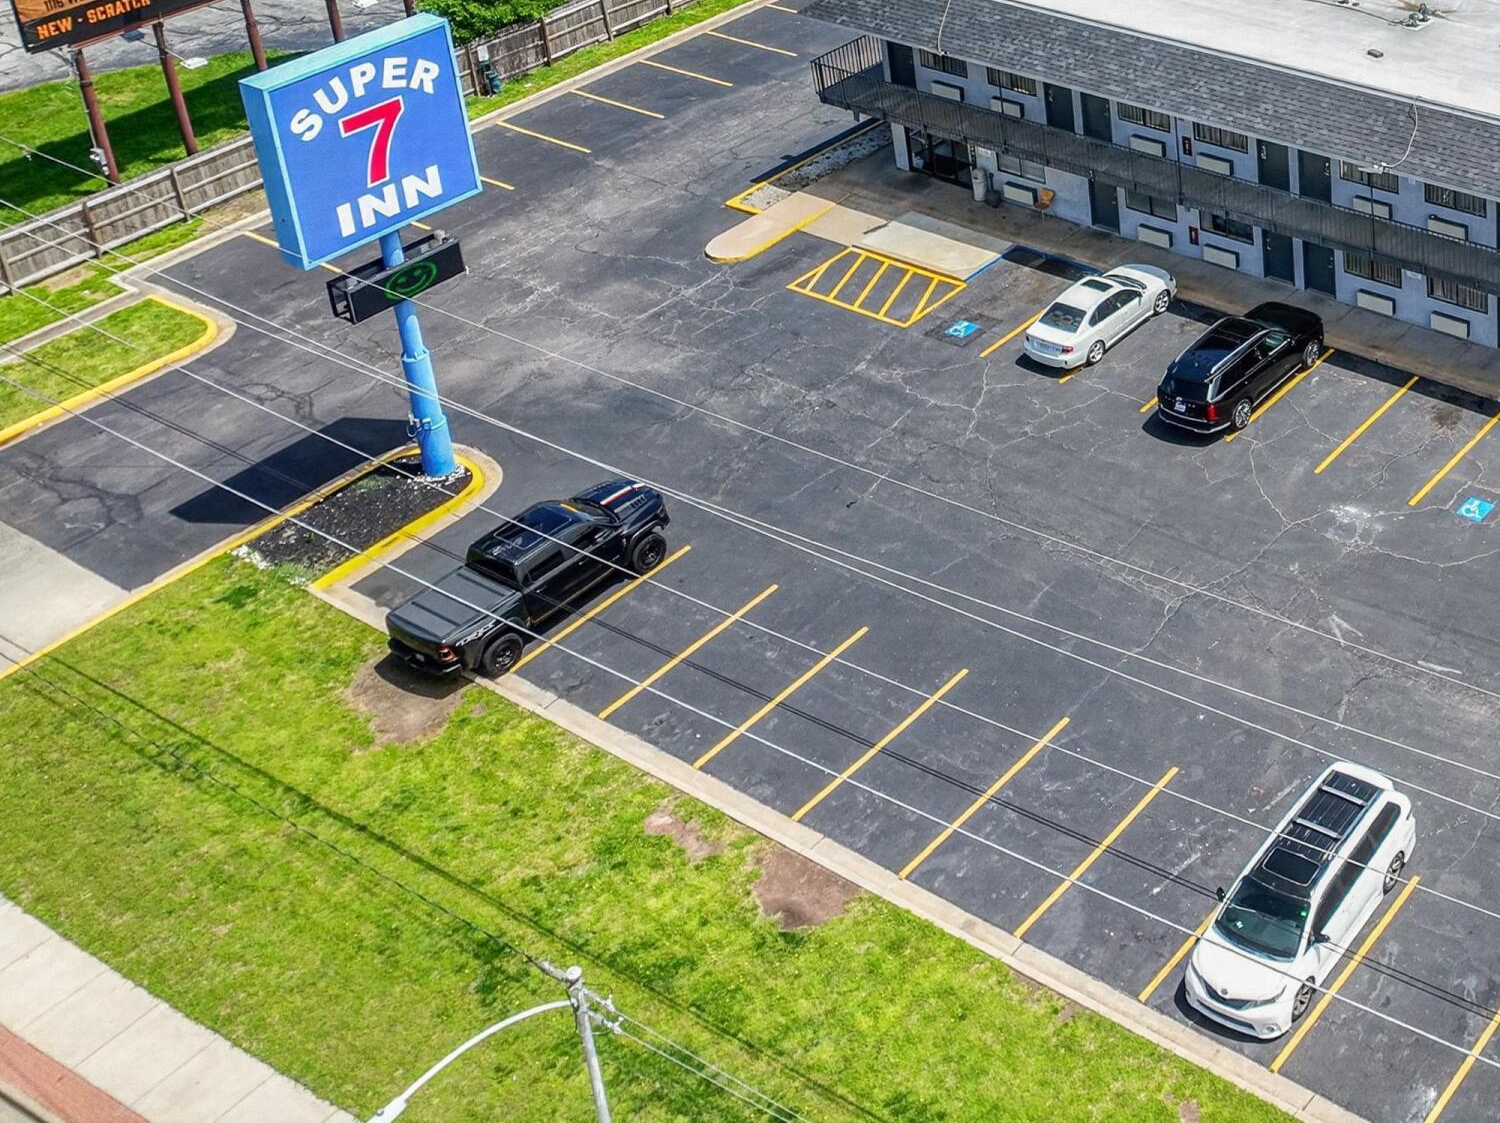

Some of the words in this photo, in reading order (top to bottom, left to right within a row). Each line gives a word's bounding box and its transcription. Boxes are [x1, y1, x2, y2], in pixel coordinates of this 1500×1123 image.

[36, 16, 72, 39] NEW
[290, 56, 440, 142] SUPER
[338, 95, 404, 188] 7
[336, 164, 443, 238] INN
